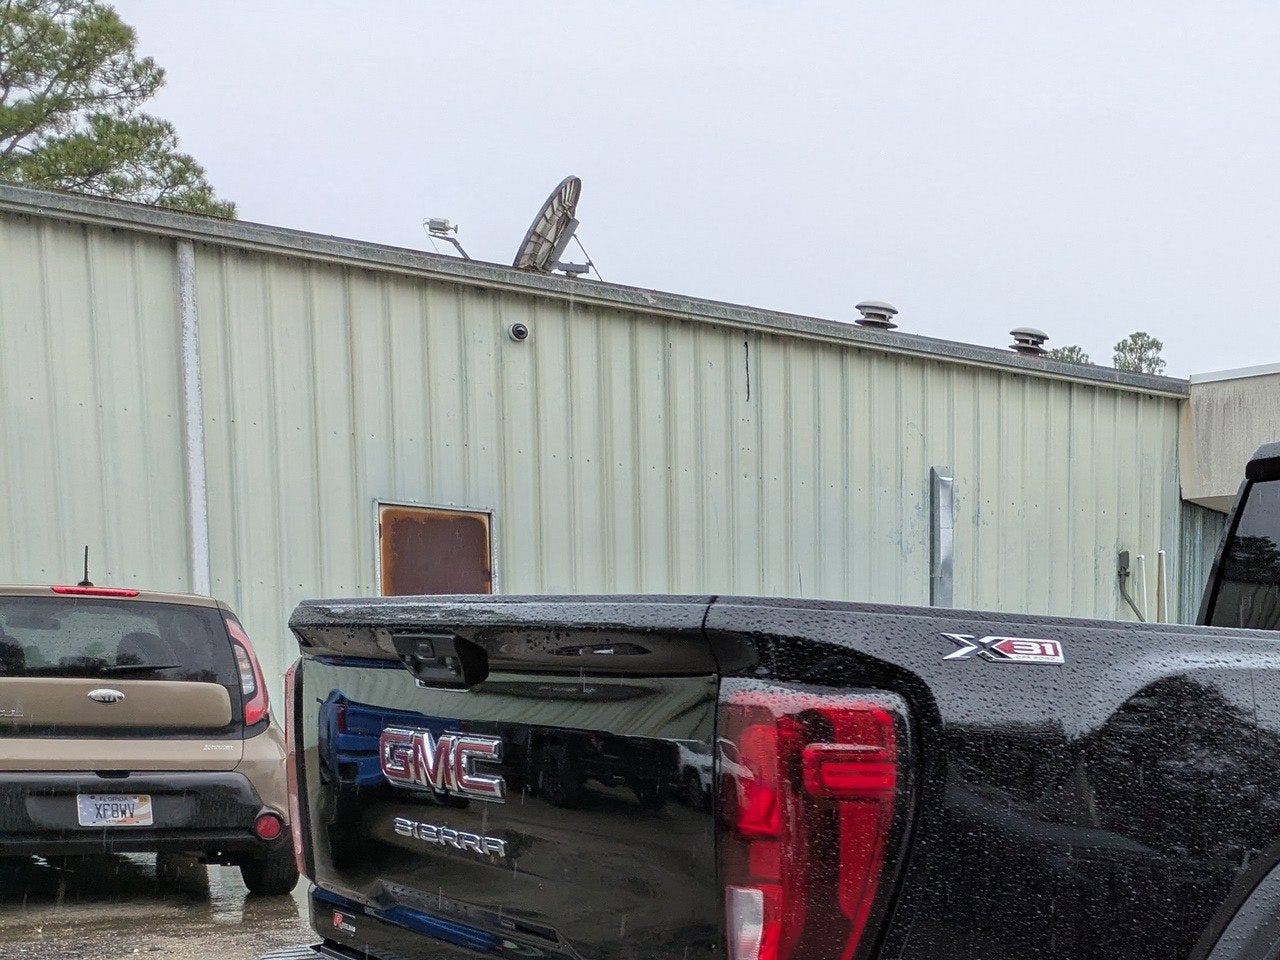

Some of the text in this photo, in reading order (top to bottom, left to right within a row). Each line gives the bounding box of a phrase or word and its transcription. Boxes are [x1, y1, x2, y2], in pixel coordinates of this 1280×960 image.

[940, 632, 1065, 664] X31
[379, 725, 506, 803] GMC
[393, 816, 507, 857] SIERRA
